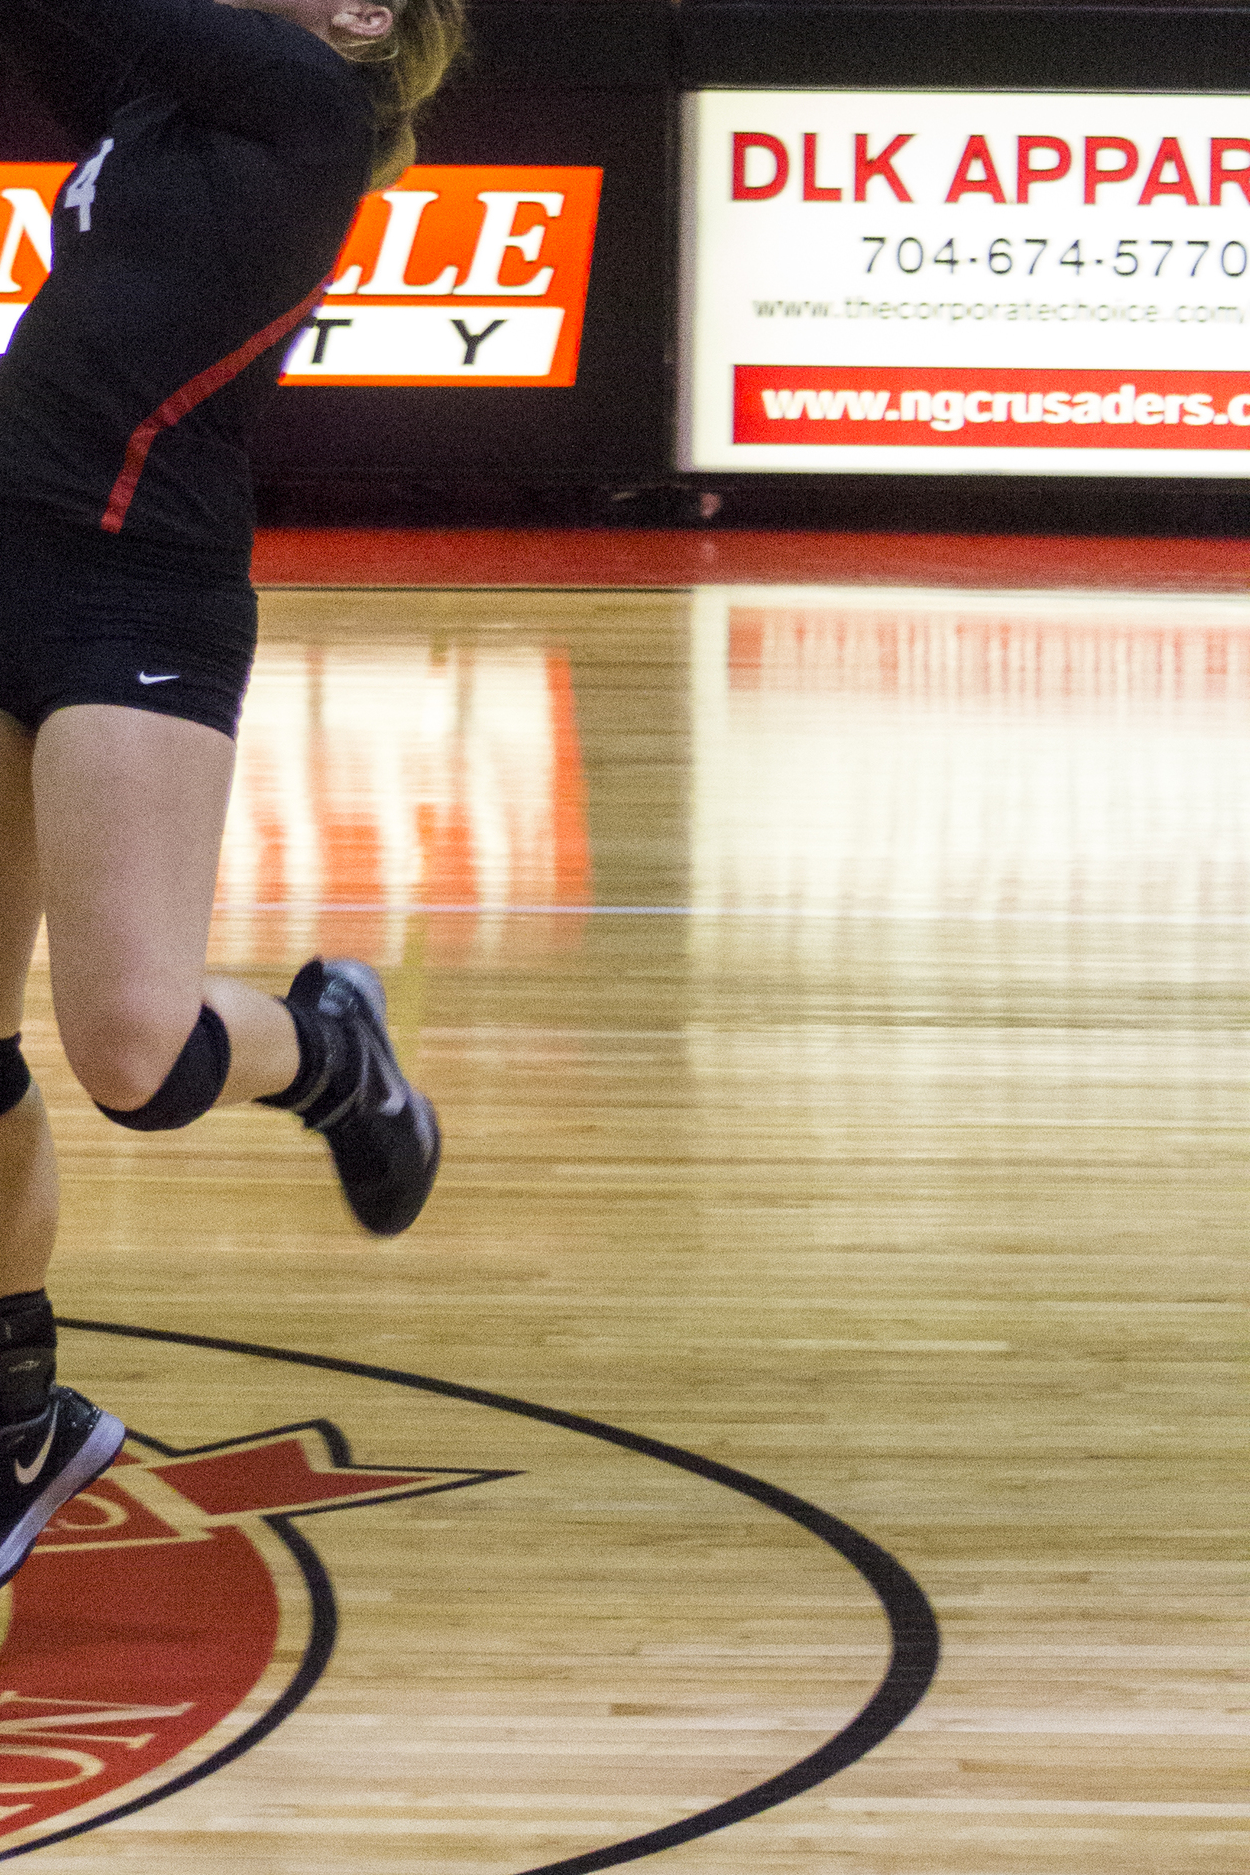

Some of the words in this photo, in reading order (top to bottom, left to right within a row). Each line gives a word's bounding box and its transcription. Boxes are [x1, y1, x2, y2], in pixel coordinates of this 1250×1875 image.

[63, 138, 115, 232] 4
[731, 132, 917, 203] DLK
[945, 134, 1250, 207] APPAR
[861, 236, 1249, 277] 704-674-5770
